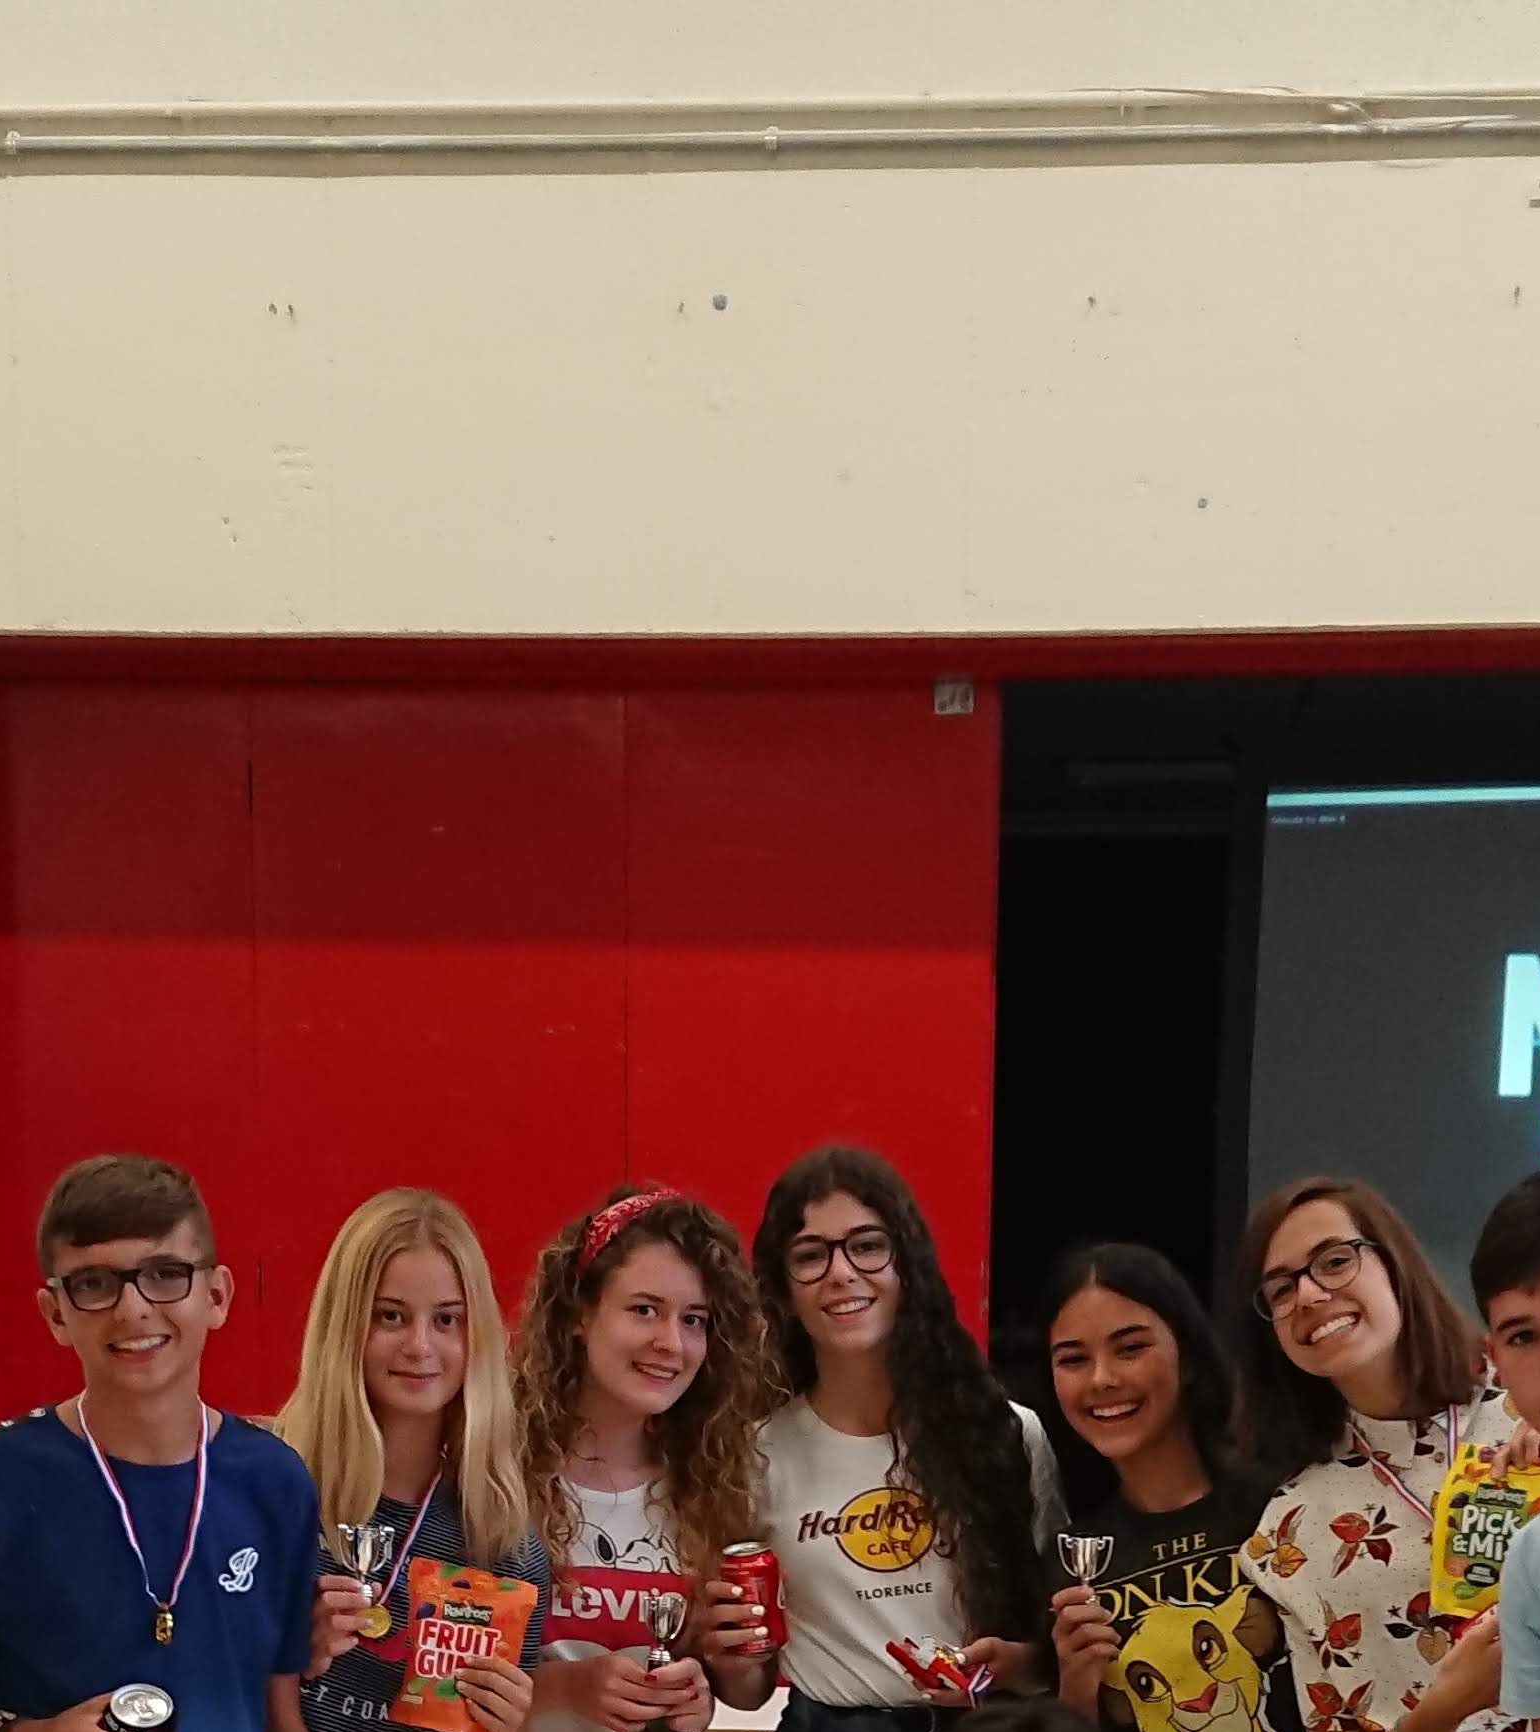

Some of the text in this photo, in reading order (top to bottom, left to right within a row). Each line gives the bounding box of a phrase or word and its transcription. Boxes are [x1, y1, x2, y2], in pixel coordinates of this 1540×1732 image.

[797, 1503, 883, 1543] Hard
[1461, 1504, 1522, 1535] Pick
[1152, 1532, 1208, 1561] THE
[855, 1582, 933, 1600] FLORENCE
[420, 1620, 499, 1657] FRUIT
[342, 1696, 389, 1721] COA
